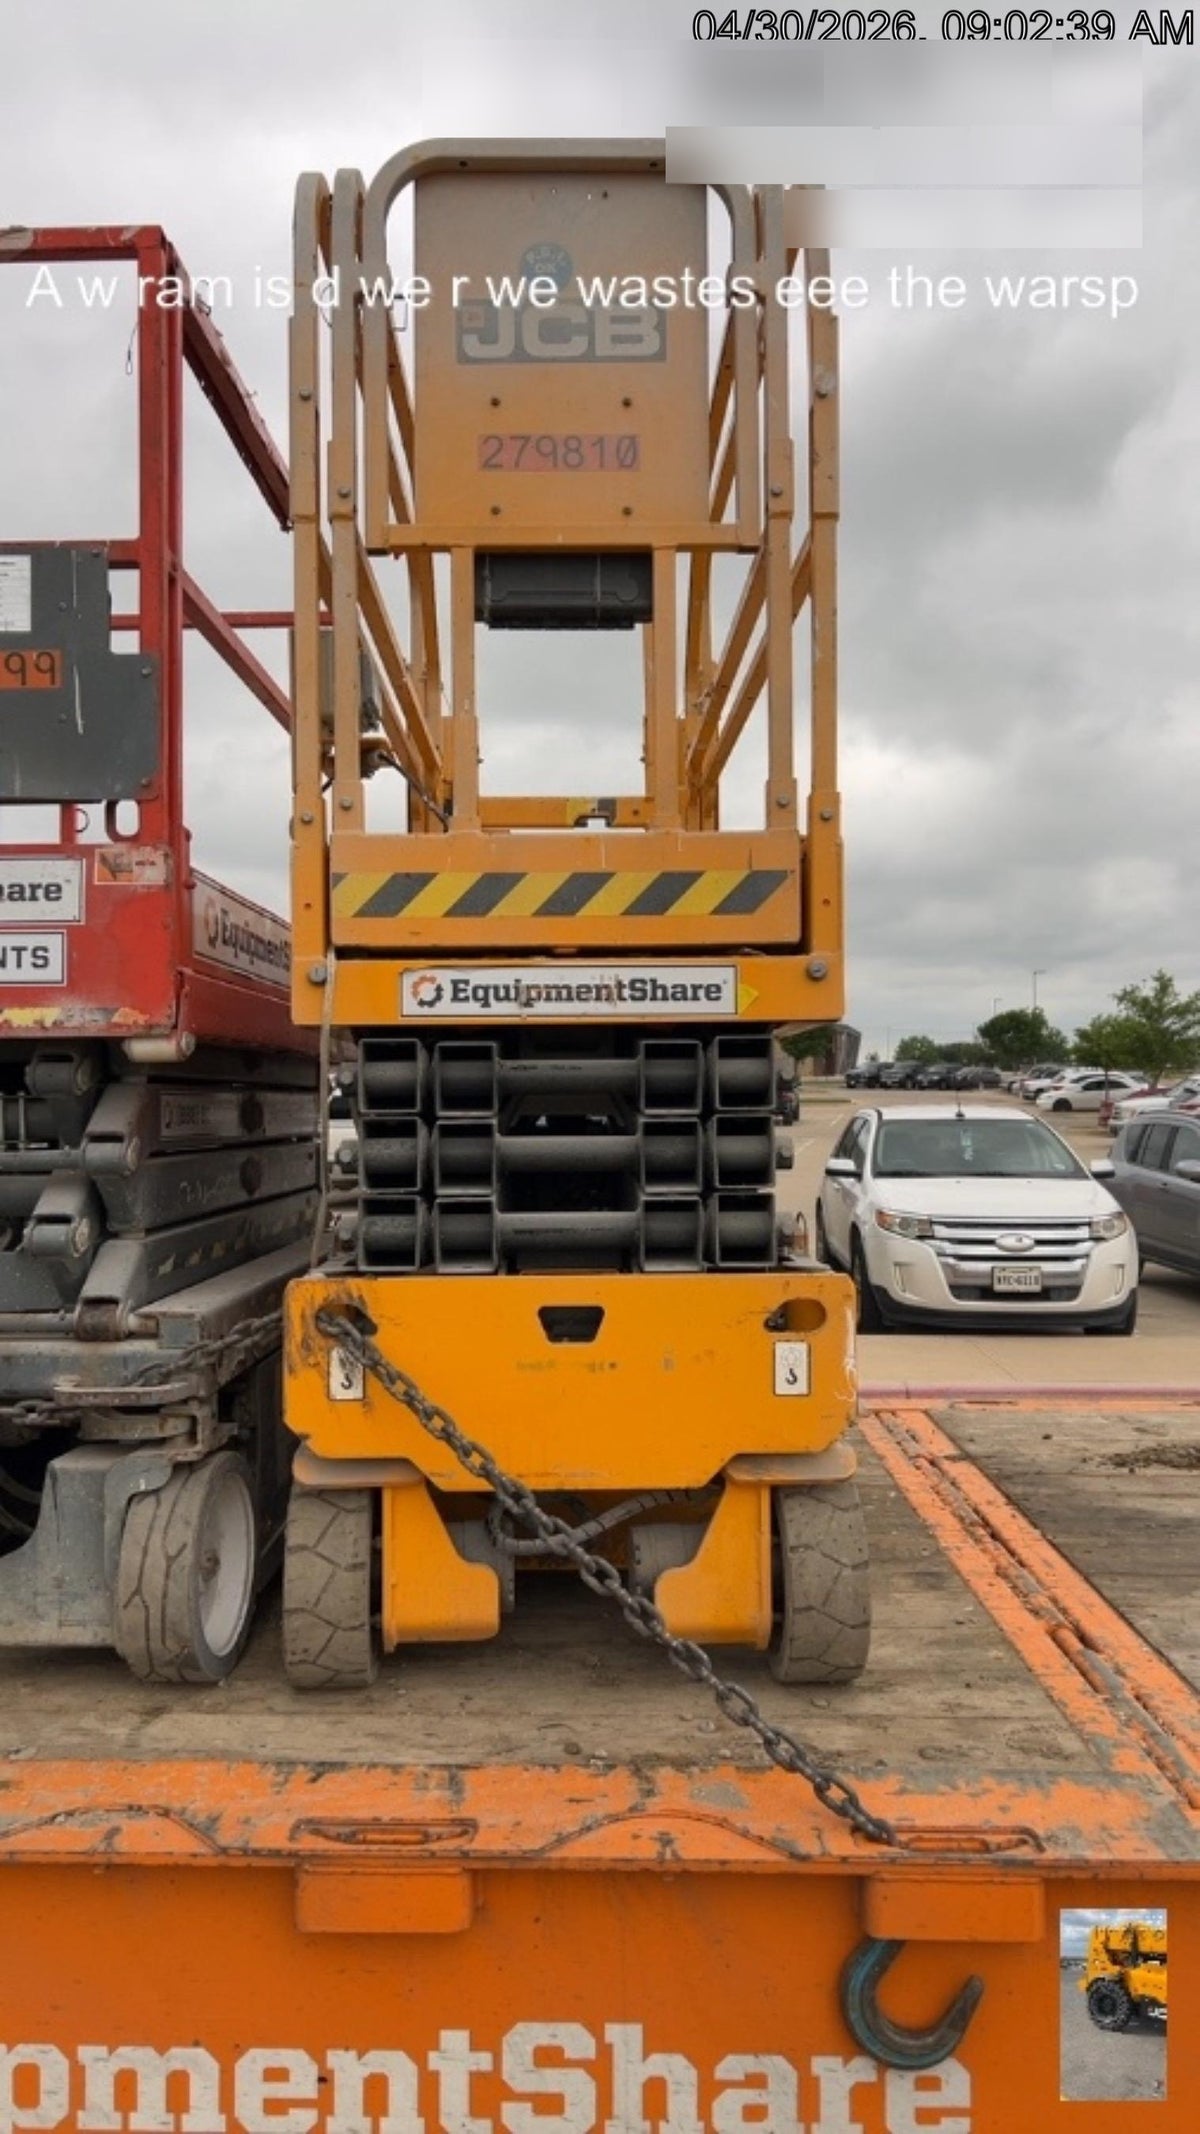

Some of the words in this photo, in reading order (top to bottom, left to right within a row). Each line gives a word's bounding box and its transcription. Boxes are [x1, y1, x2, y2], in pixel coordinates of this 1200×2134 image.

[461, 299, 661, 359] JCB
[481, 434, 638, 469] 279810
[0, 880, 63, 902] are
[449, 977, 723, 1009] EquipmentShare
